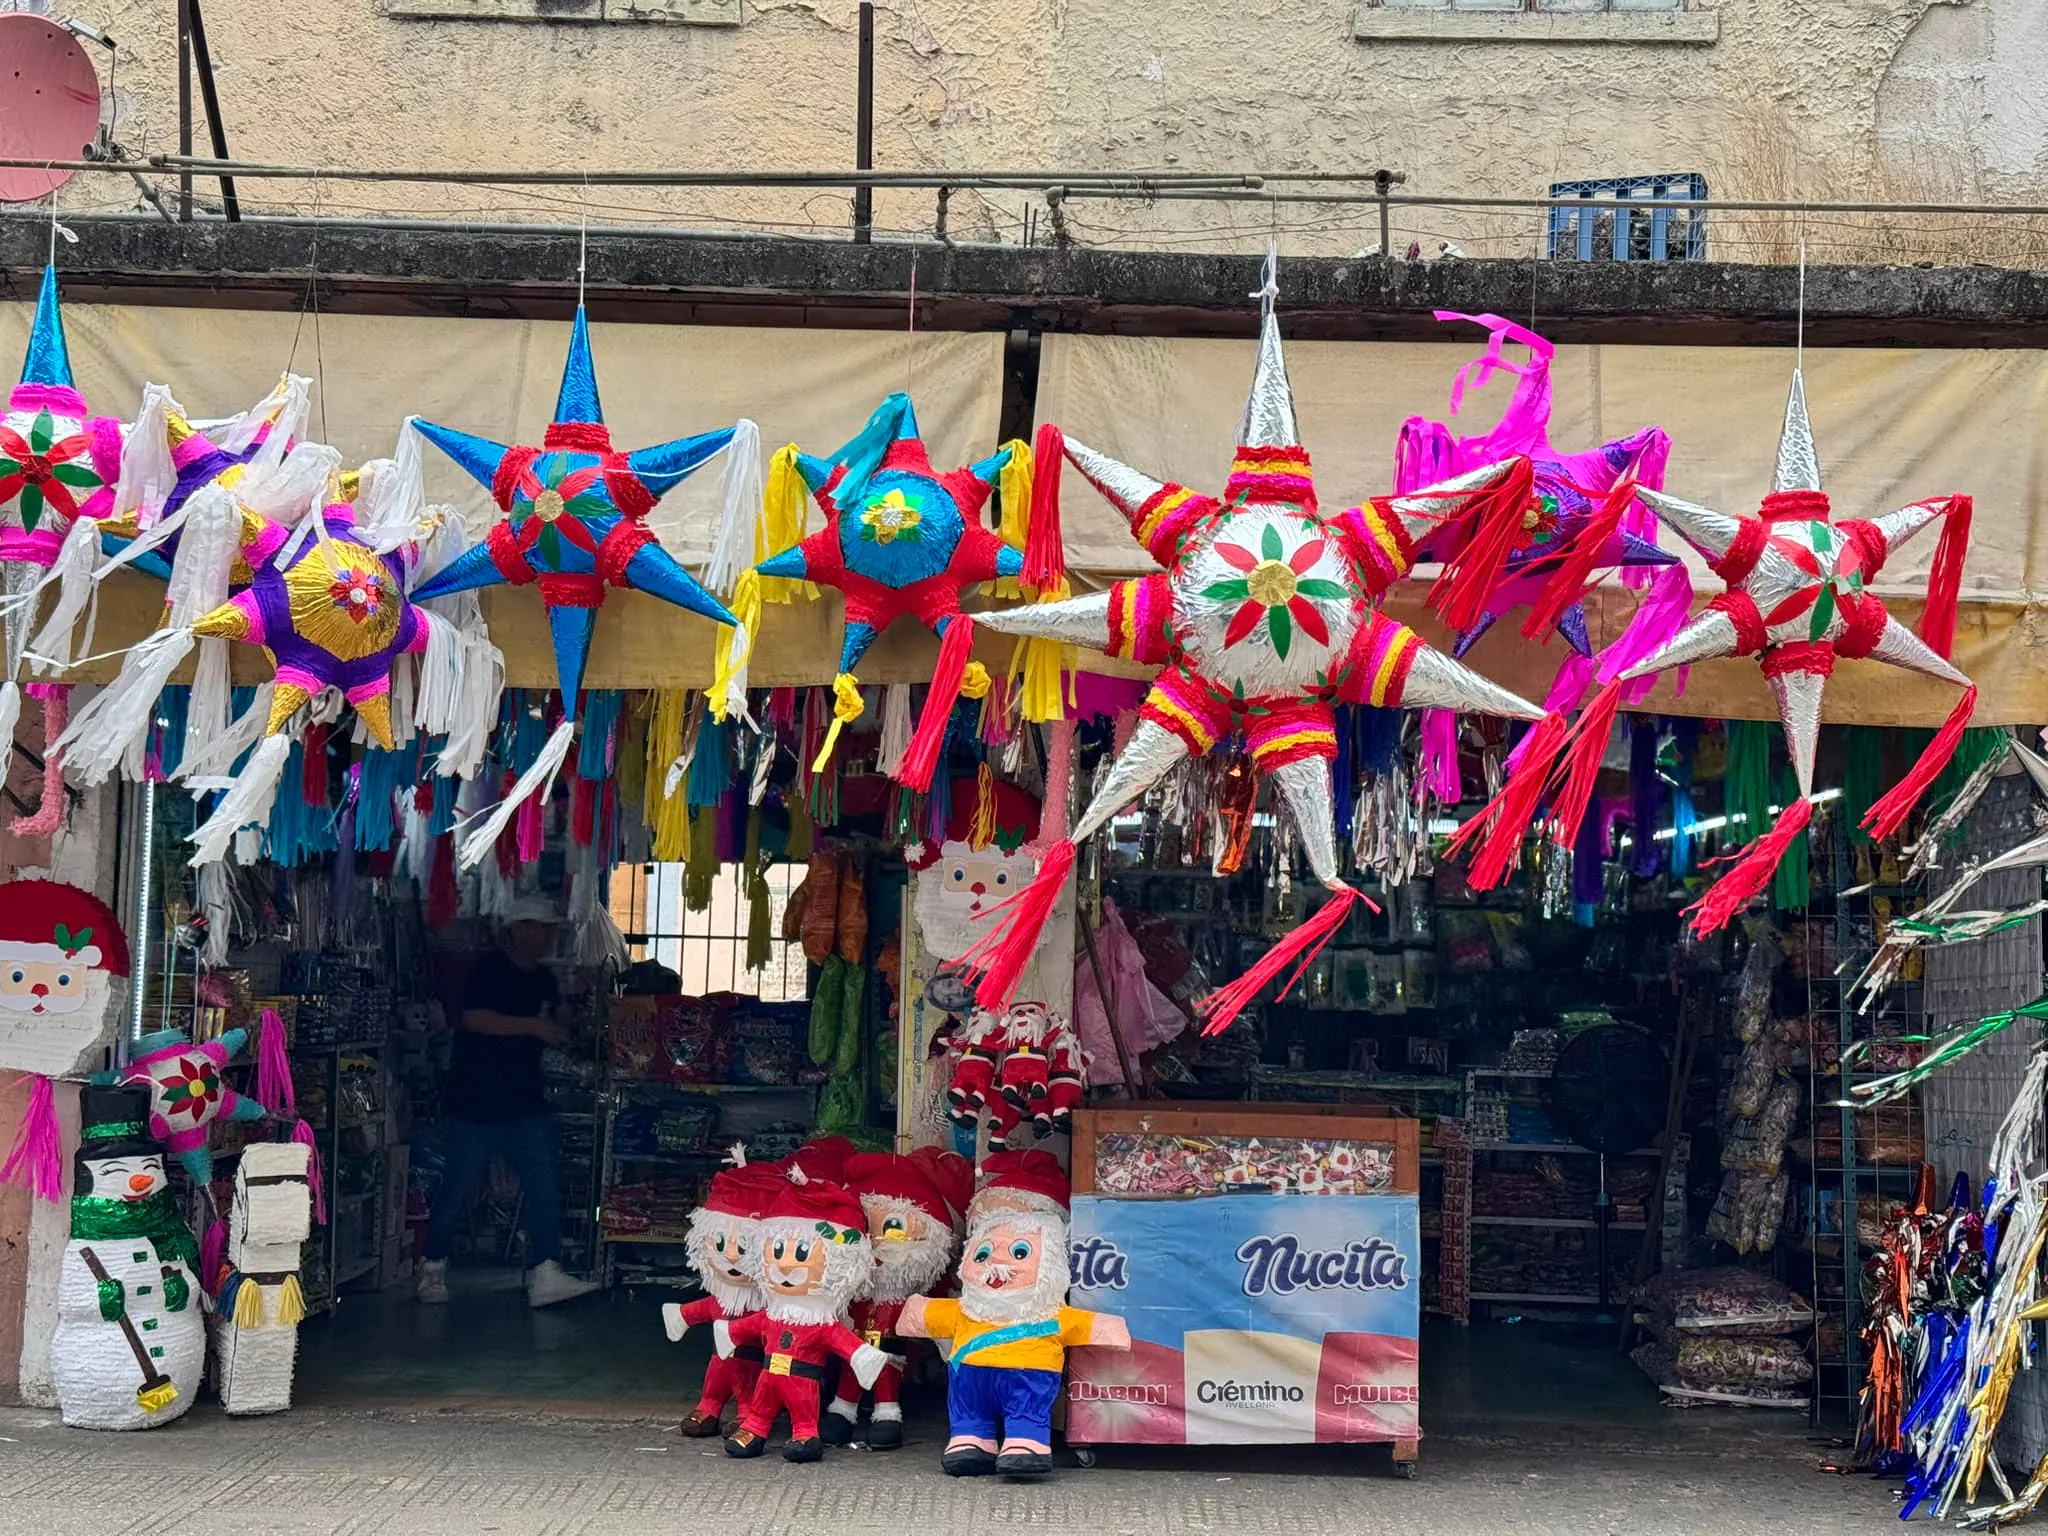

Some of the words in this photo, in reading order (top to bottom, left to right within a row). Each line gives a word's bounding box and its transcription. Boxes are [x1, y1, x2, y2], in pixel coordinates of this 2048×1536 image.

[1238, 1234, 1407, 1296] Nucita
[1197, 1379, 1304, 1404] Crémino
[1225, 1401, 1276, 1409] AVELLANA
